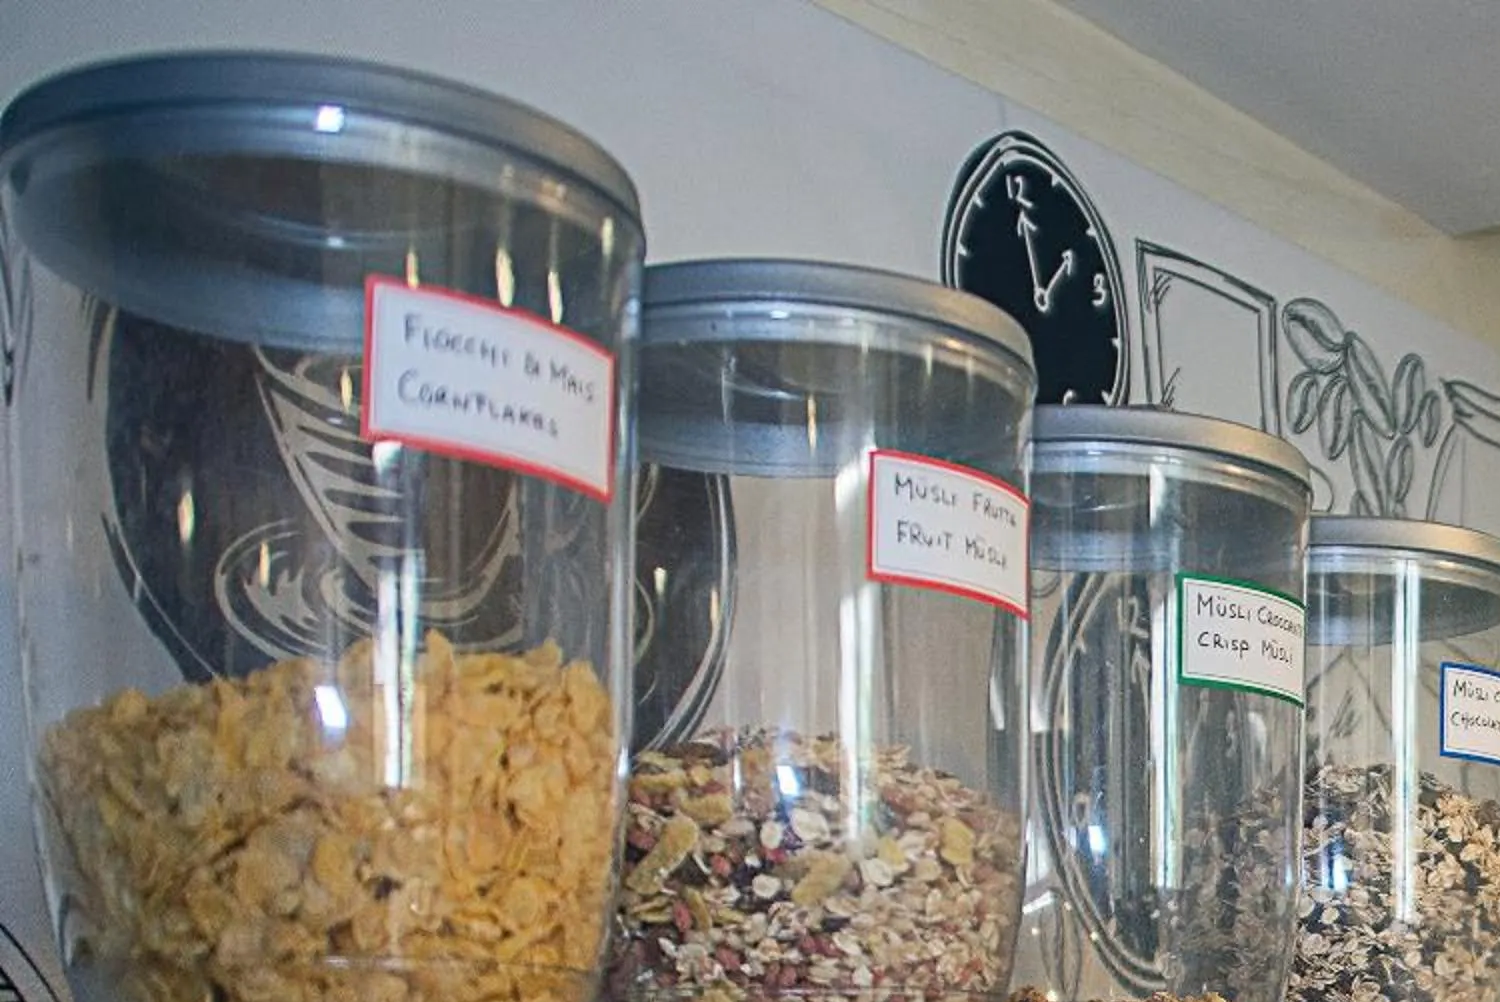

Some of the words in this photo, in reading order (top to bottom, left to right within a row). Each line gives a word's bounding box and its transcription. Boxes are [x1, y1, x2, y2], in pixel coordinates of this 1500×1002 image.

[1005, 174, 1033, 209] 12
[1091, 272, 1107, 306] 3
[896, 520, 954, 551] FRUIT
[1196, 591, 1251, 622] MÜSLI
